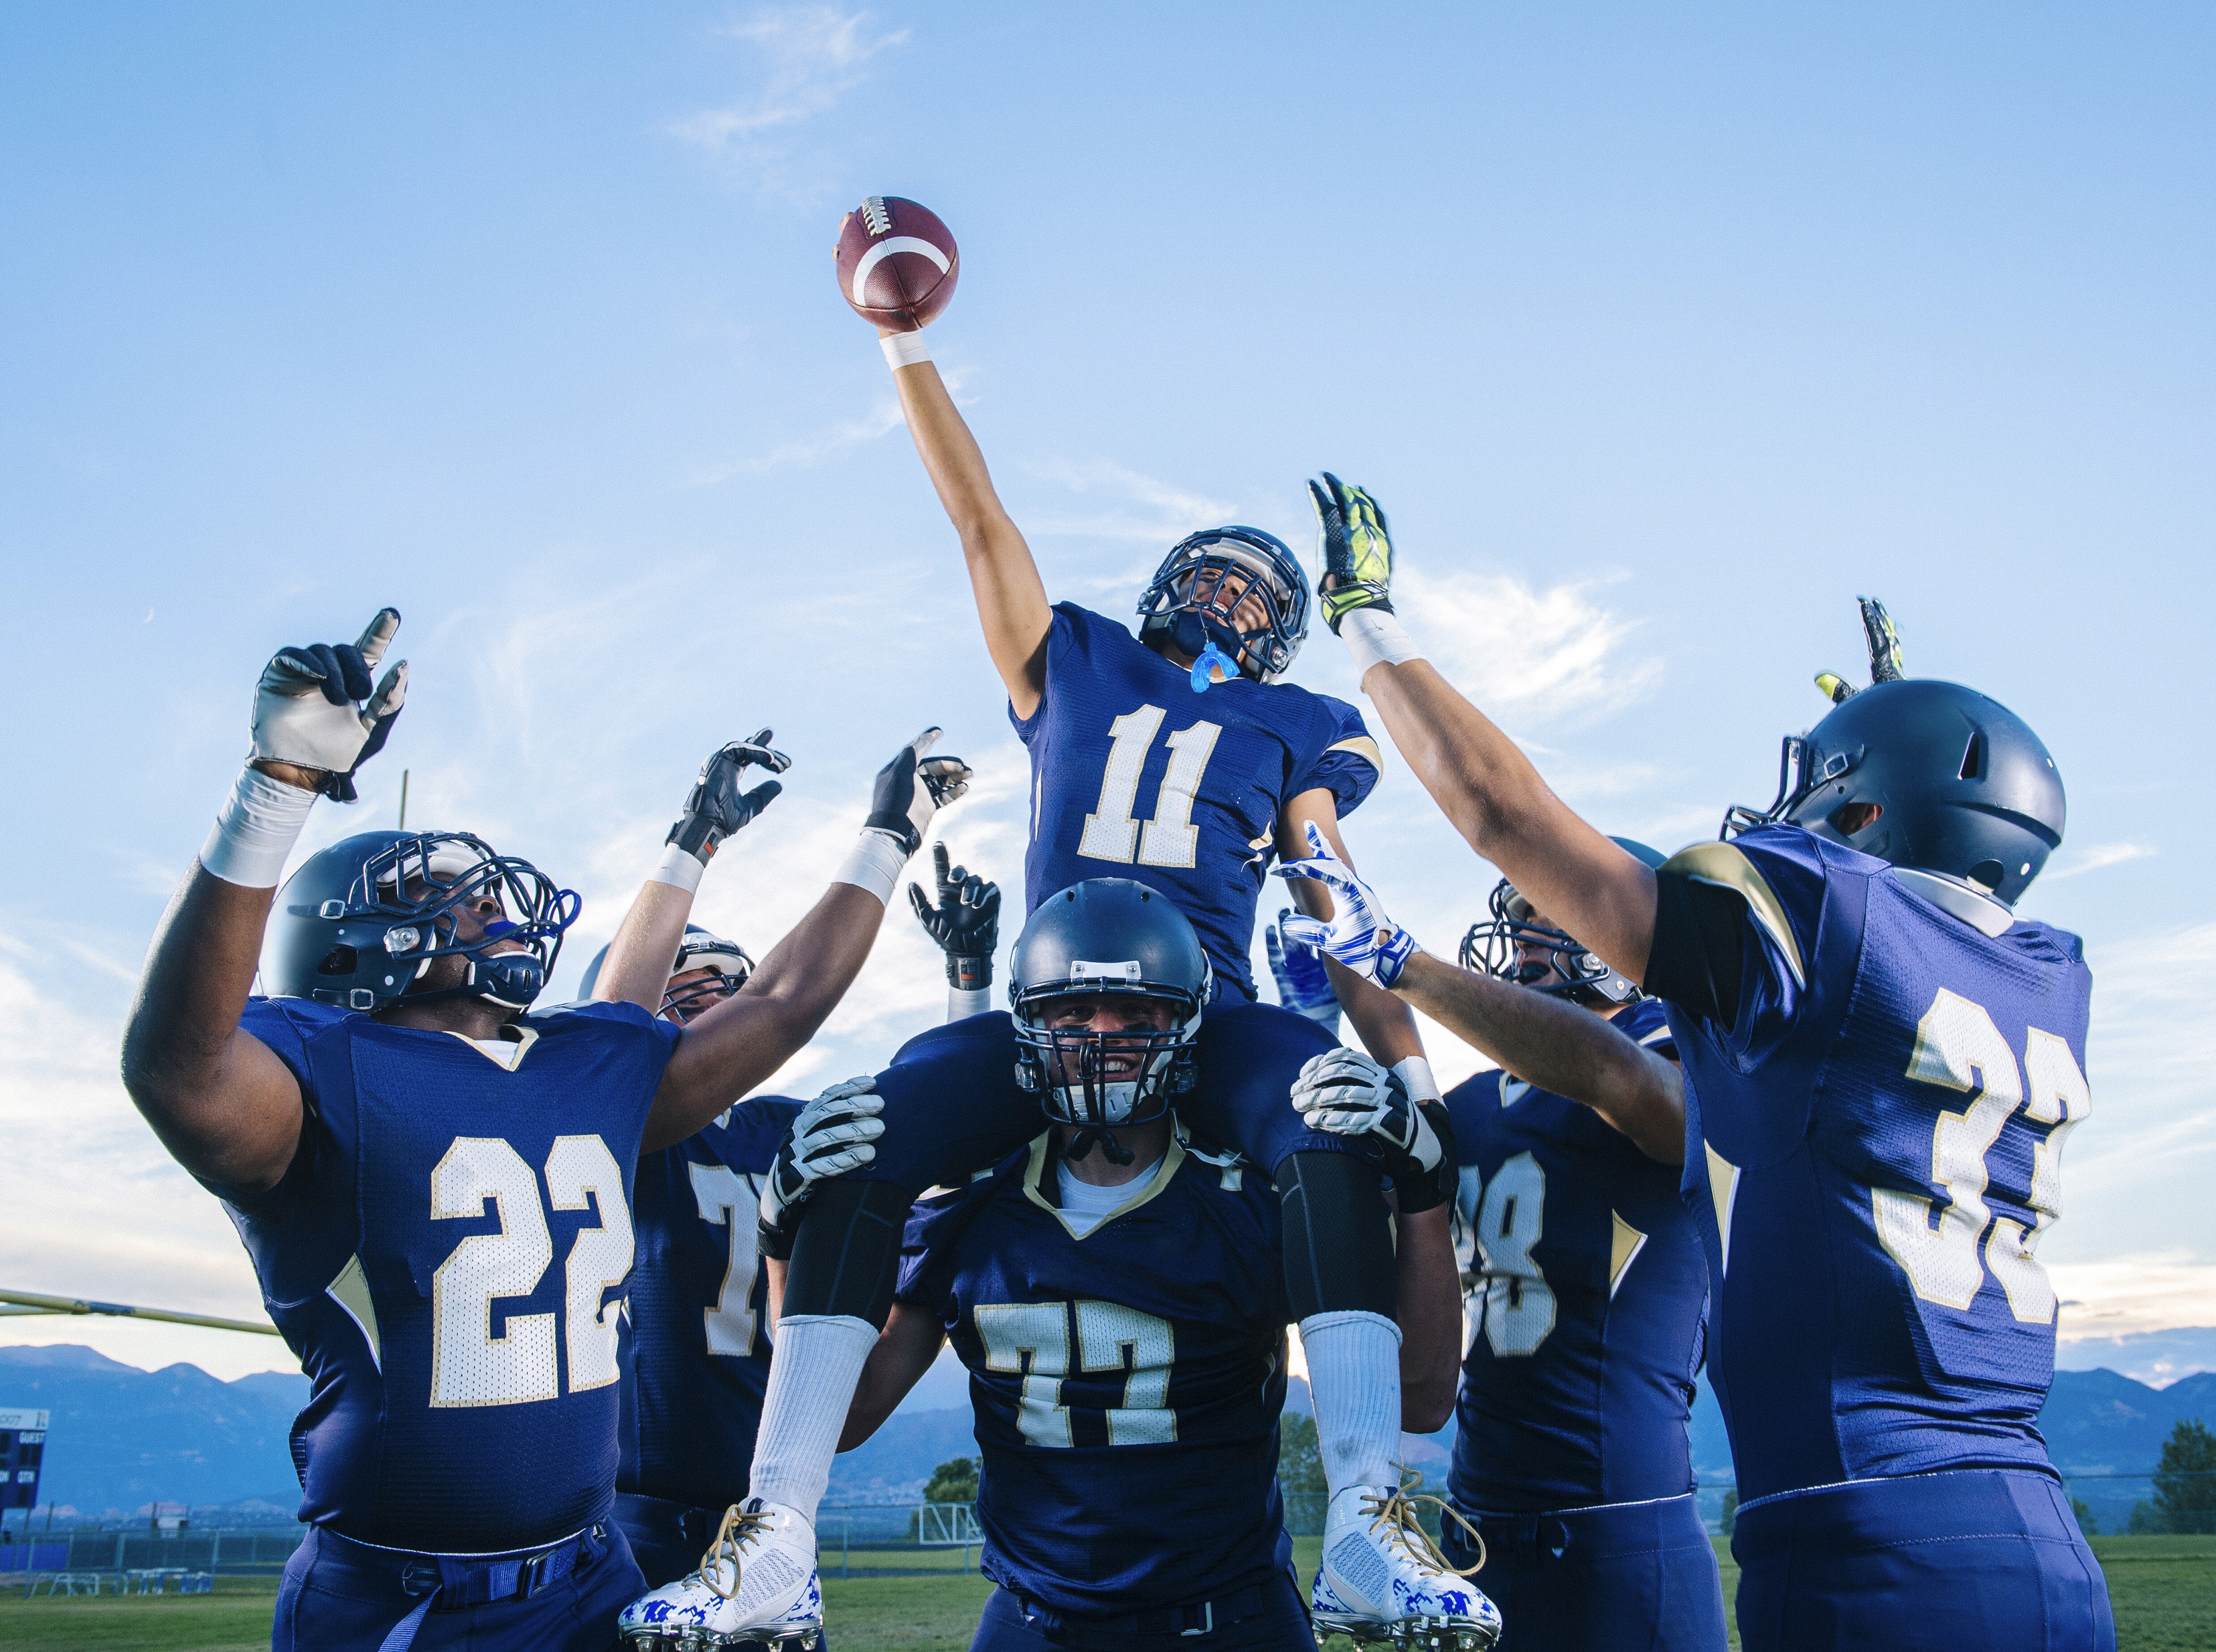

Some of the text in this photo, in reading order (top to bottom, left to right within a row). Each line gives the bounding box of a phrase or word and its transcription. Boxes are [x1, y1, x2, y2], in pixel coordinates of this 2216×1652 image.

[1077, 704, 1222, 868] 11
[1871, 987, 2092, 1324] 33
[429, 1134, 635, 1408] 22
[688, 1161, 774, 1357] 7
[974, 1299, 1178, 1448] 77
